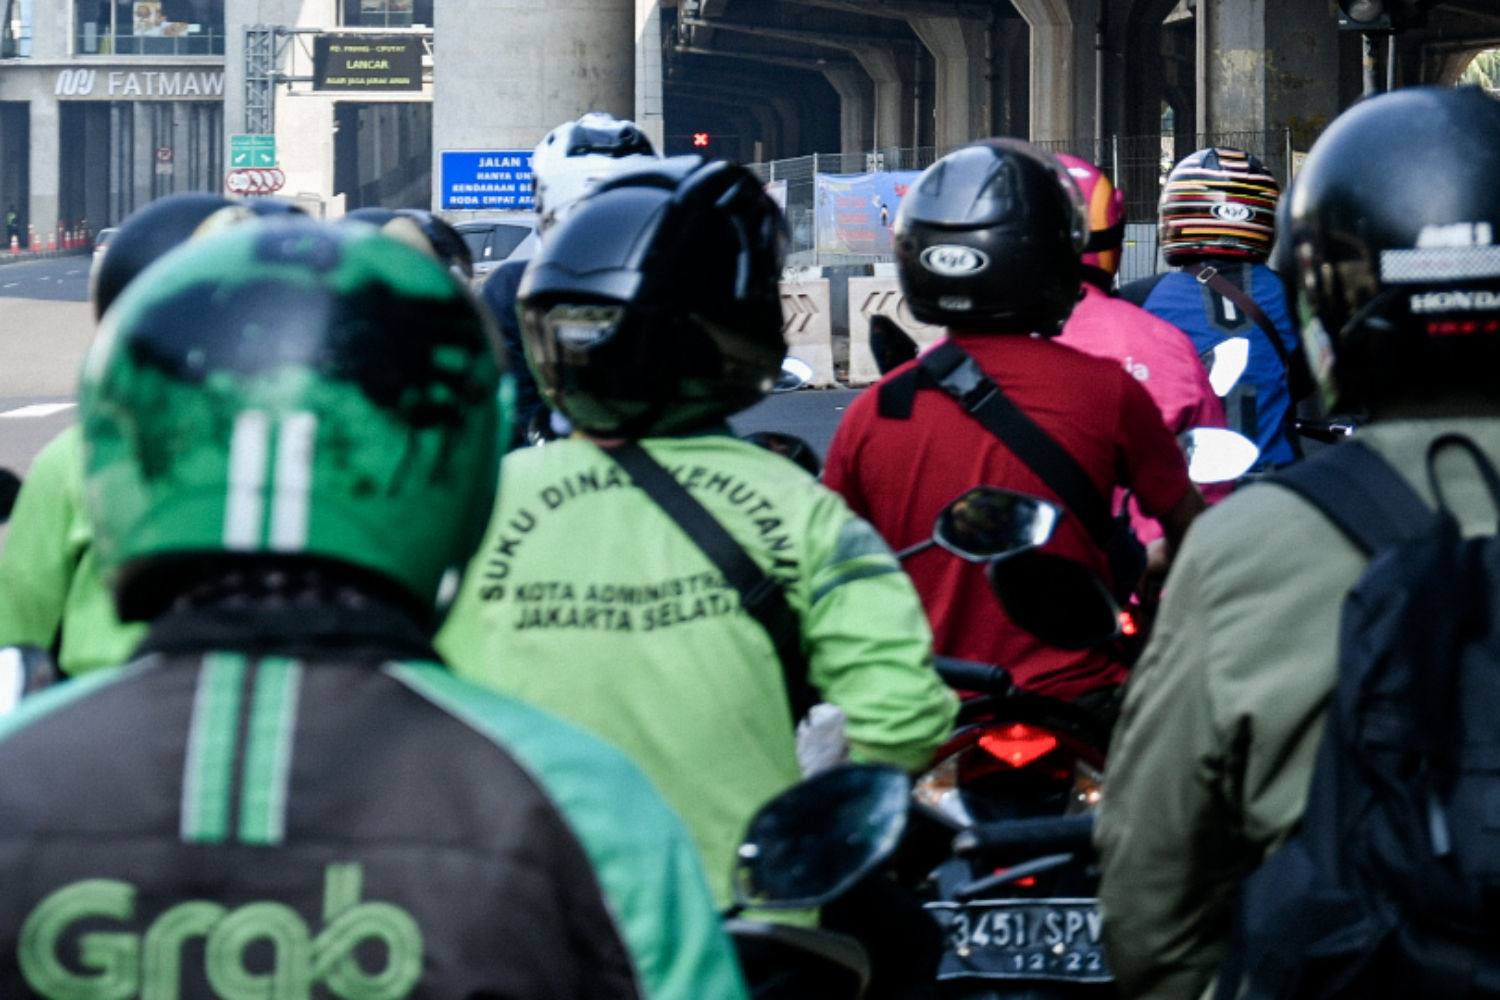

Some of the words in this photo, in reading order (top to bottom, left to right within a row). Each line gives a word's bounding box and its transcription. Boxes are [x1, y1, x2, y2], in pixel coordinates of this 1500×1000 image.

[107, 71, 225, 97] FATMAW
[345, 60, 389, 70] LANCAR
[478, 156, 521, 168] JALAN
[479, 507, 536, 601] SUKU
[540, 464, 631, 510] DINA
[515, 579, 575, 602] KOTA
[584, 568, 727, 606] ADMINISTR
[514, 605, 633, 632] JAKARTA
[642, 593, 744, 631] SELATA
[16, 861, 425, 1000] Grab
